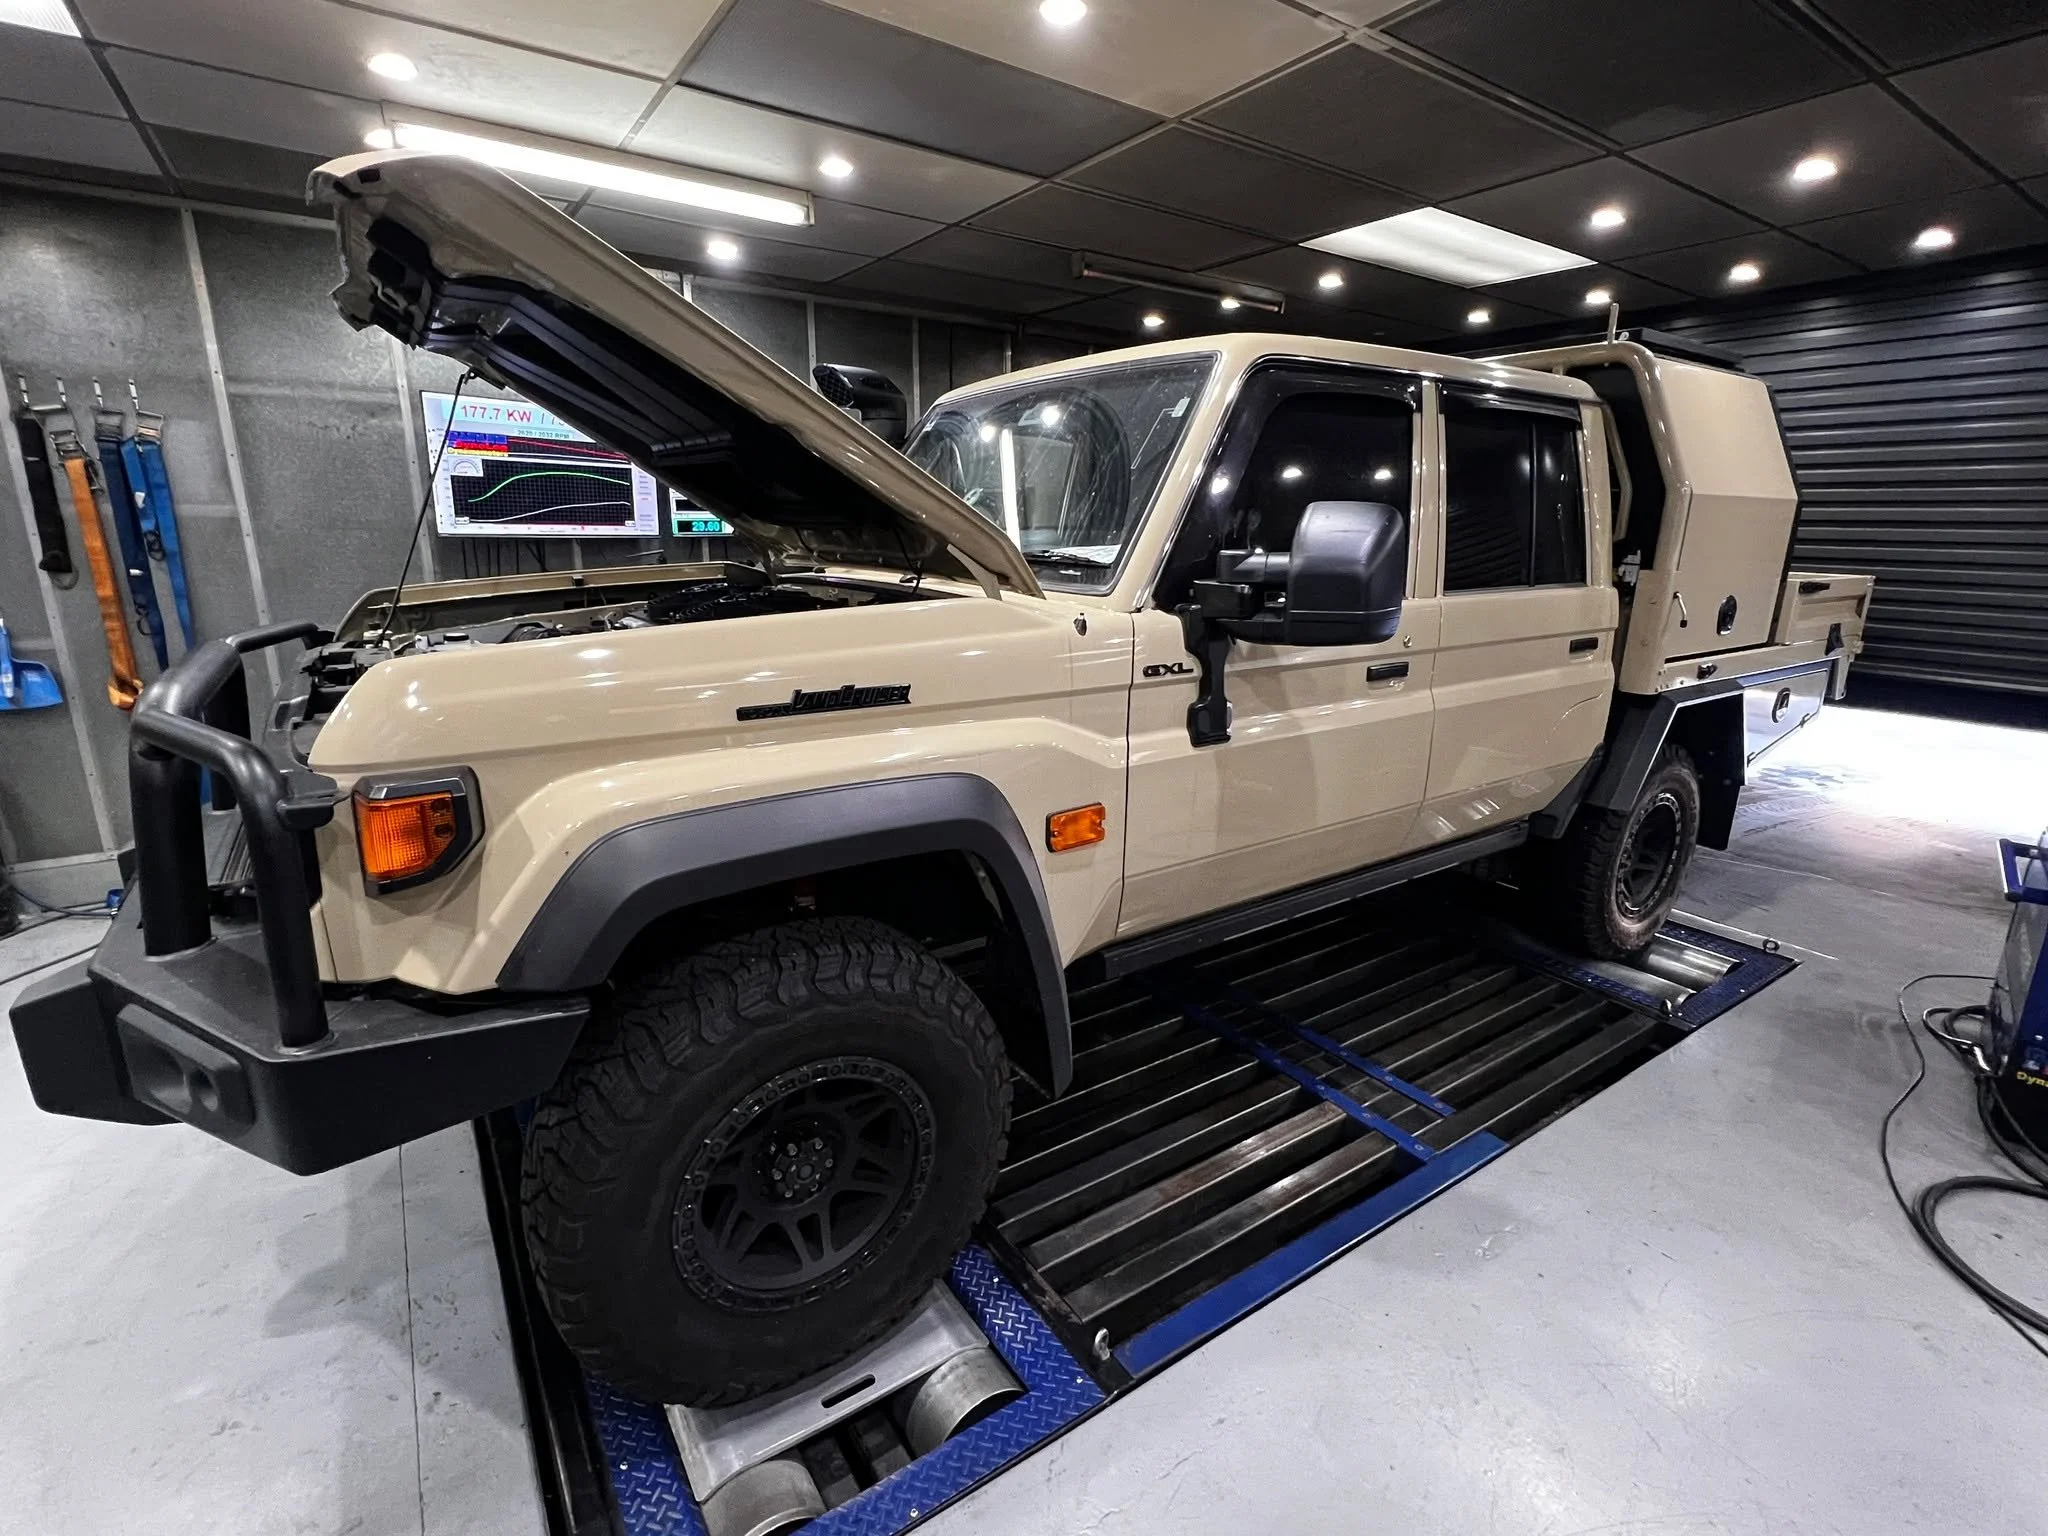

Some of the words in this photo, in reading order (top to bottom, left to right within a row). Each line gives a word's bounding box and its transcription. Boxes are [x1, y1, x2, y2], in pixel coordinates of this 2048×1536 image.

[461, 405, 500, 420] 177.7
[506, 408, 532, 423] KW
[1143, 662, 1194, 677] GXL
